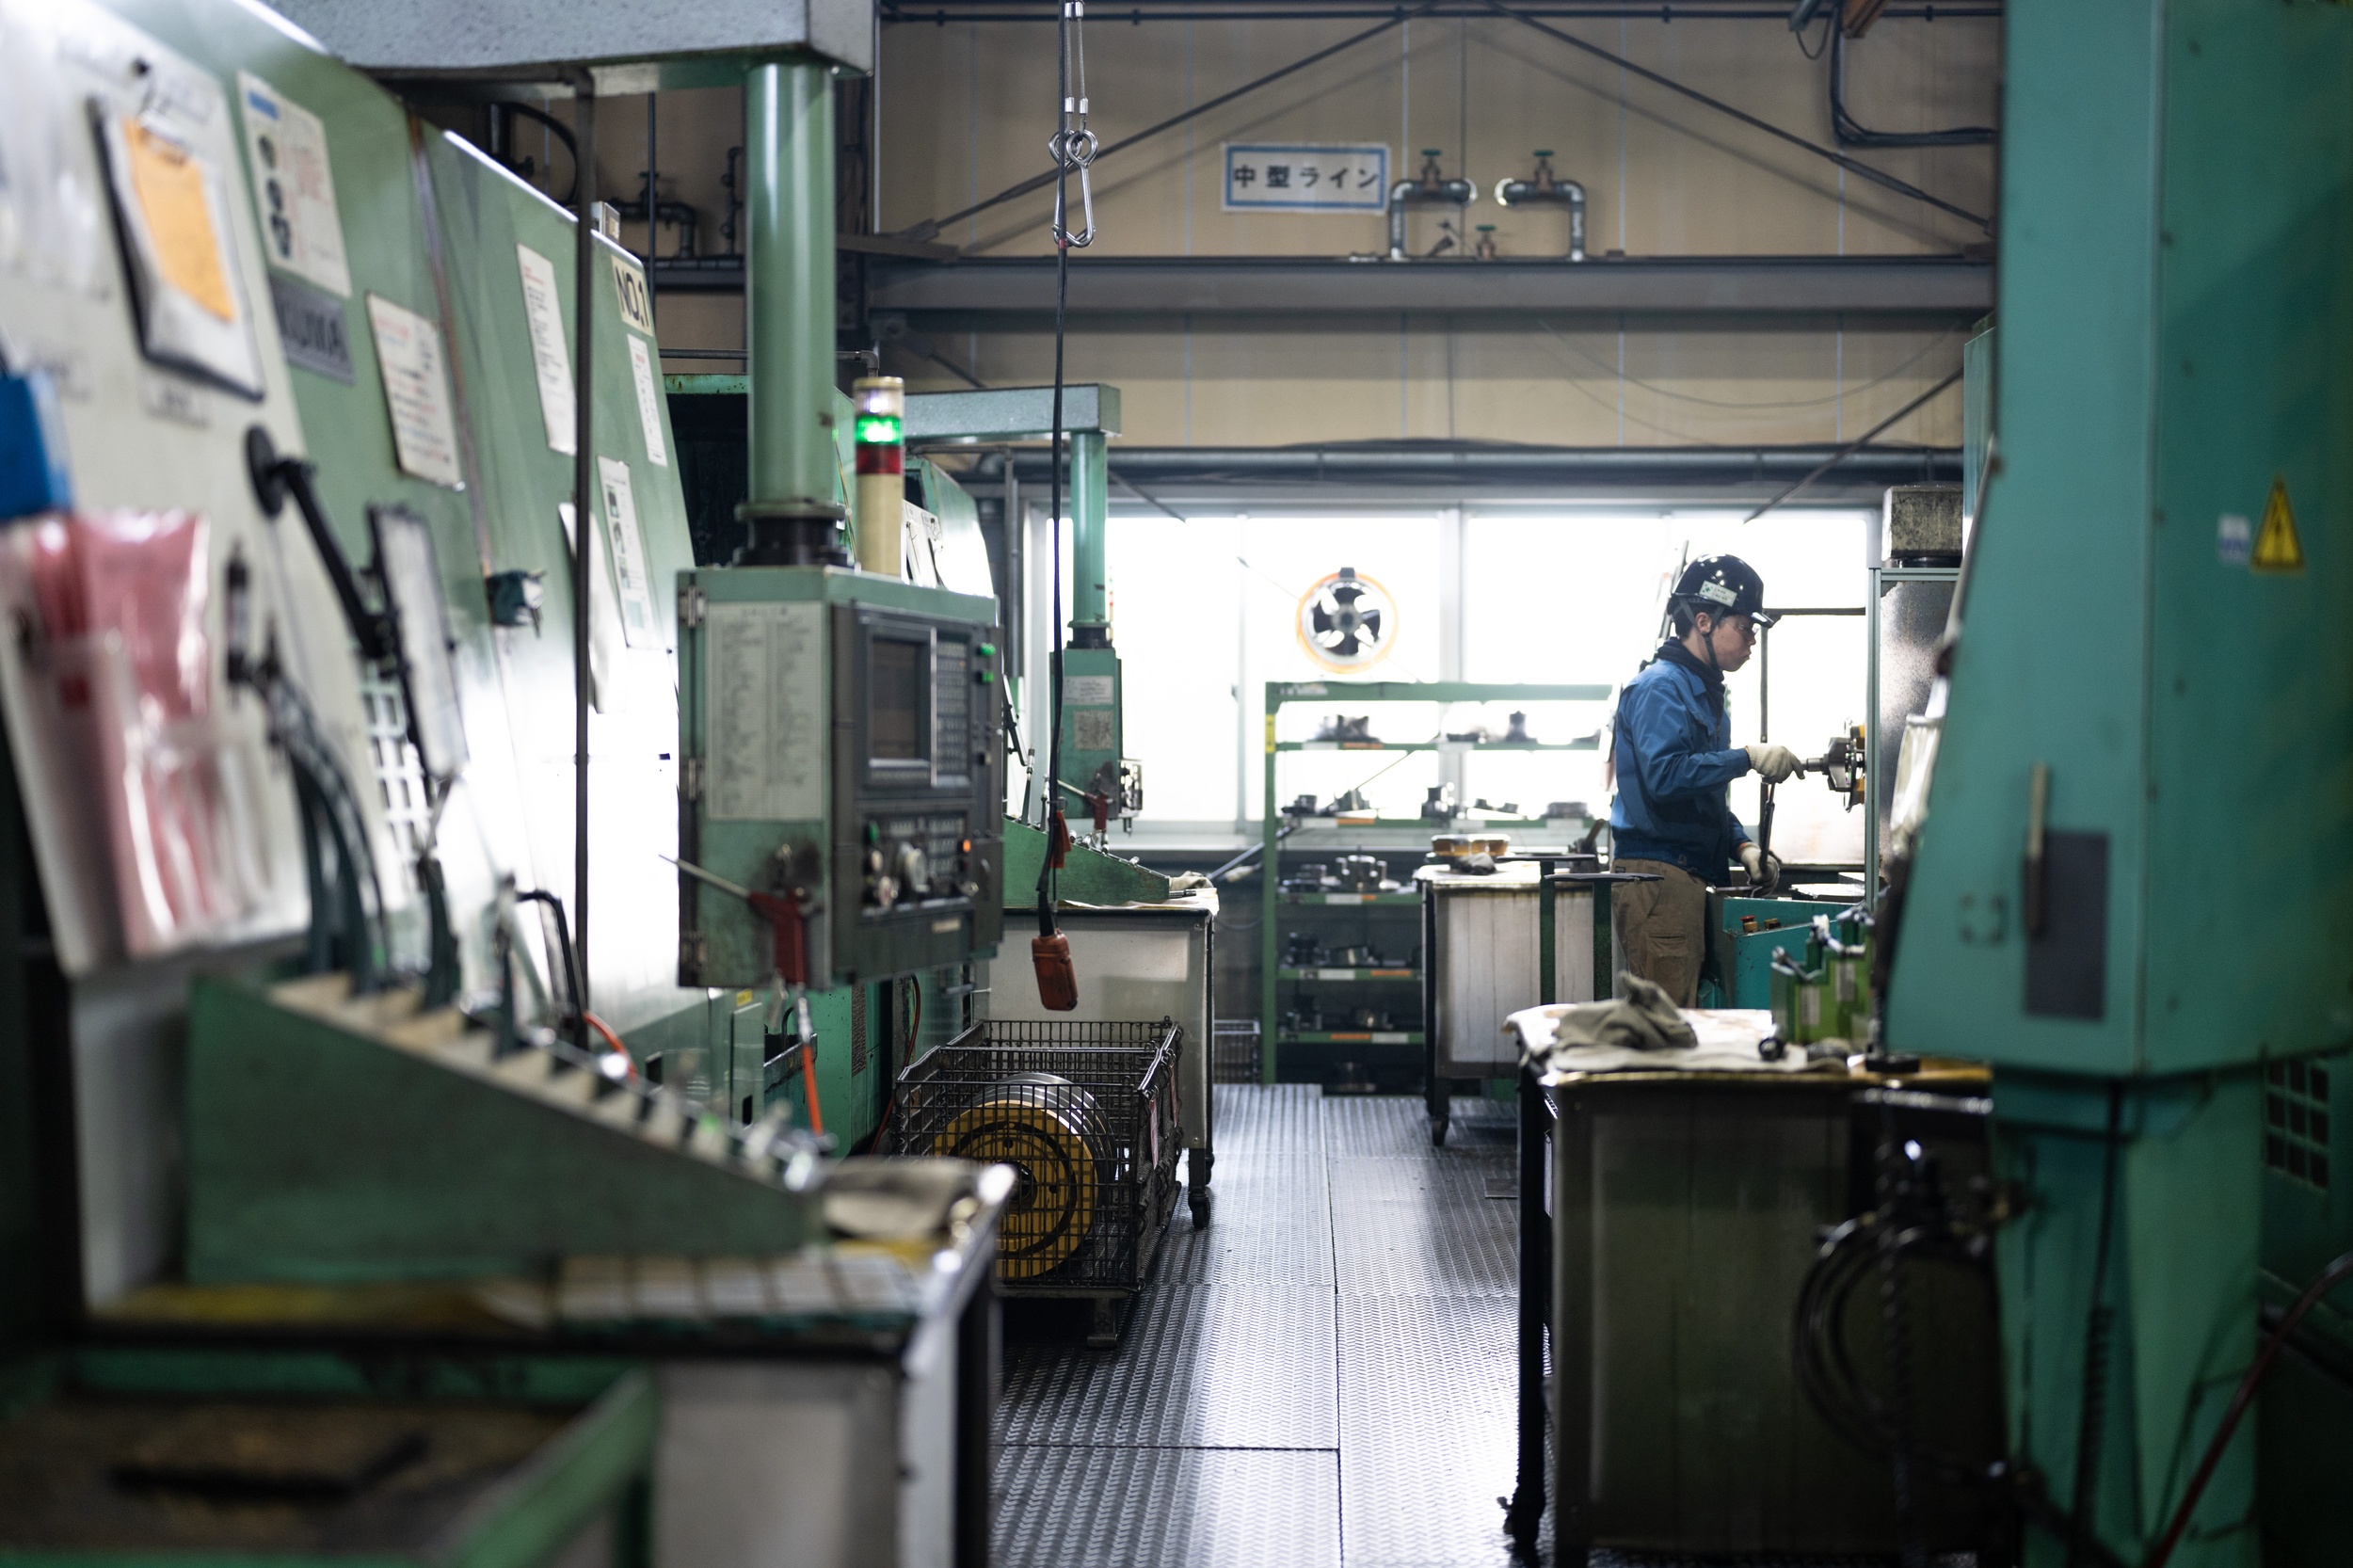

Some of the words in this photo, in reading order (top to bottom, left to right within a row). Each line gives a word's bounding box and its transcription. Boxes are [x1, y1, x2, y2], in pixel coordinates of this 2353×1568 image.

[1234, 165, 1379, 188] 中型ライン
[615, 265, 649, 328] NO.1
